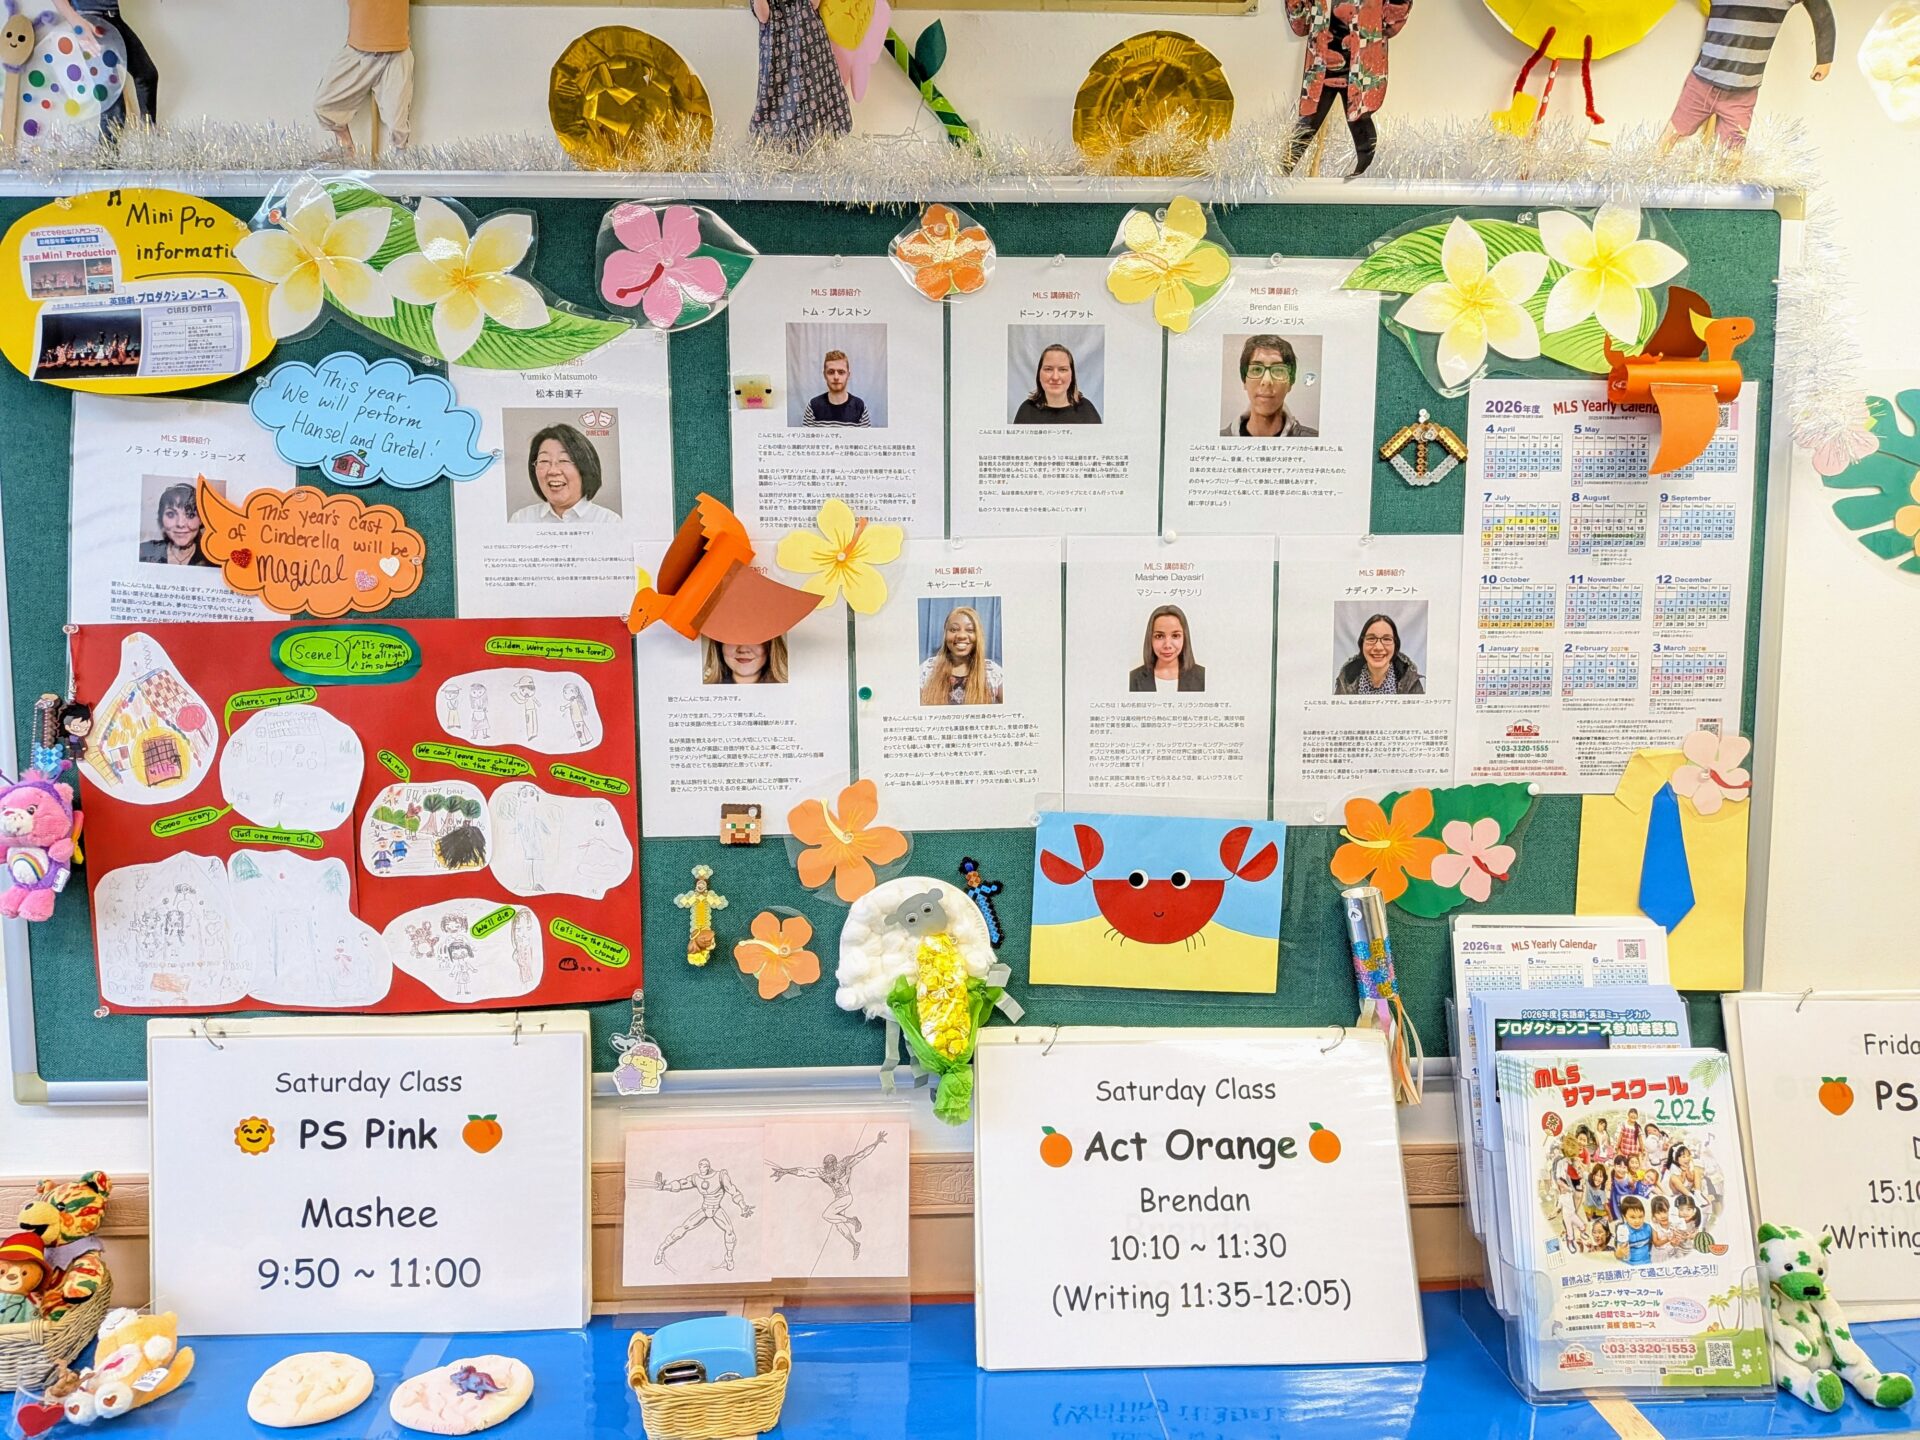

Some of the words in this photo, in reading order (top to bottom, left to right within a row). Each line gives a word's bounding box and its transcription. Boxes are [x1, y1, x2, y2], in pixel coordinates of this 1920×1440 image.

[125, 203, 174, 228] Mini
[180, 206, 216, 235] Pro
[42, 251, 64, 261] Mini
[66, 248, 117, 259] Production
[810, 288, 828, 297] MLS
[830, 288, 862, 297] 講師紹介
[1032, 291, 1049, 299] MLS
[1050, 291, 1081, 300] 講師紹介
[1250, 287, 1267, 296] MLS
[1268, 286, 1299, 296] 講師紹介
[167, 305, 189, 315] CLASS
[191, 304, 213, 313] DATA
[802, 306, 872, 317] トム・プレストン
[1249, 303, 1282, 311] Brendan
[1283, 303, 1299, 311] Ellis
[1019, 309, 1093, 319] ドーン・ワイアット
[1241, 316, 1305, 326] ブレンダン・エリス
[322, 368, 359, 394] This
[520, 372, 552, 381] Yumiko
[554, 373, 598, 381] Matsumoto
[535, 389, 583, 399] 松本由美子
[282, 381, 309, 404] We
[319, 394, 348, 412] will
[354, 404, 424, 430] perform
[1485, 399, 1541, 414] 2026年度
[1552, 399, 1579, 416] MLS
[1580, 399, 1617, 416] Yearly
[292, 410, 349, 444] Hansel
[350, 432, 375, 449] and
[585, 429, 609, 437] DIRECTOR
[1485, 424, 1495, 434] 4
[1497, 424, 1516, 435] April
[1573, 424, 1583, 434] 5
[1585, 425, 1601, 435] May
[160, 434, 178, 443] MLS
[179, 435, 212, 445] 講師紹介
[125, 445, 247, 462] ノラ・イゼッタ・ジョーンズ
[1483, 492, 1493, 503] 7
[1494, 492, 1511, 503] July
[1571, 492, 1580, 503] 8
[1583, 492, 1610, 503] August
[1659, 492, 1669, 503] 9
[1671, 493, 1711, 503] September
[257, 504, 291, 521] This
[298, 508, 341, 527] year's
[348, 514, 383, 535] cast
[227, 523, 247, 542] of
[260, 524, 340, 552] Cinderella
[352, 540, 383, 554] will
[390, 541, 410, 558] be
[934, 567, 951, 576] MLS
[952, 567, 984, 575] 講師紹介
[1143, 562, 1162, 570] MLS
[1163, 562, 1195, 571] 講師紹介
[1134, 573, 1169, 582] Mashee
[1170, 573, 1205, 583] Dayasiri
[1358, 569, 1375, 577] MLS
[1375, 569, 1406, 577] 講師紹介
[926, 580, 992, 589] キャシー・ピエール
[1480, 574, 1497, 584] 10
[1499, 575, 1530, 584] October
[1568, 574, 1584, 584] 11
[1587, 575, 1626, 584] November
[1656, 574, 1673, 584] 12
[1674, 575, 1713, 584] December
[1136, 588, 1202, 598] マシー・ダヤシリ
[1344, 586, 1418, 596] ナディア・アーント
[294, 645, 333, 660] Scene
[335, 644, 341, 660] 1
[1478, 643, 1485, 653] 1
[1488, 644, 1519, 654] January
[1564, 643, 1573, 653] 2
[1575, 643, 1609, 654] February
[1652, 643, 1662, 653] 3
[1663, 644, 1686, 653] March
[269, 696, 282, 706] my
[1513, 724, 1533, 734] MLS
[1501, 744, 1549, 753] 03-3320-1555
[417, 746, 431, 756] We
[454, 751, 475, 761] leave
[494, 757, 527, 769] children
[472, 761, 487, 770] the
[553, 768, 566, 778] We
[568, 771, 588, 781] have
[588, 777, 601, 786] no
[234, 830, 251, 839] Just
[272, 834, 291, 842] more
[475, 919, 495, 933] We'll
[497, 911, 510, 923] die
[555, 922, 573, 935] Let's
[575, 931, 588, 941] use
[589, 934, 602, 945] the
[602, 942, 624, 954] bread
[1462, 941, 1503, 952] 2026年度
[1510, 940, 1530, 952] MLS
[1532, 939, 1557, 952] Yearly
[1558, 939, 1598, 952] Calendar
[1521, 1009, 1558, 1020] 2026年度
[1560, 1009, 1650, 1020] 英語劇・英語ミュージカル
[1497, 1020, 1679, 1038] プロダクションコース参加者募集
[1534, 1064, 1581, 1088] MLS
[275, 1071, 392, 1099] Saturday
[399, 1070, 463, 1093] Class
[1095, 1078, 1207, 1107] Saturday
[1214, 1076, 1277, 1101] Class
[1561, 1075, 1689, 1107] サマースクール
[1874, 1080, 1919, 1113] PS
[1653, 1096, 1716, 1123] 2026
[1546, 1113, 1560, 1130] 祭
[298, 1118, 348, 1151] PS
[364, 1117, 438, 1151] Pink
[1083, 1130, 1149, 1163] Act
[1164, 1128, 1299, 1170] Orange
[1139, 1186, 1252, 1213] Brendan
[300, 1195, 439, 1230] Mashee
[1109, 1233, 1181, 1261] 10:10
[1216, 1231, 1287, 1260] 11:30
[257, 1256, 341, 1291] 9:50
[389, 1256, 483, 1290] 11:00
[1052, 1284, 1171, 1318] (Writing
[1179, 1277, 1353, 1312] 11:35-12:05)
[1588, 1289, 1664, 1298] ジュニア・サマースクール
[1591, 1299, 1661, 1308] シニア・サマースクール
[1594, 1310, 1660, 1319] 4日間でミュージカル
[1606, 1321, 1620, 1330] 英検
[1622, 1321, 1656, 1330] 合格コース
[1610, 1343, 1697, 1355] 03-3320-1553
[1565, 1353, 1586, 1363] MLS
